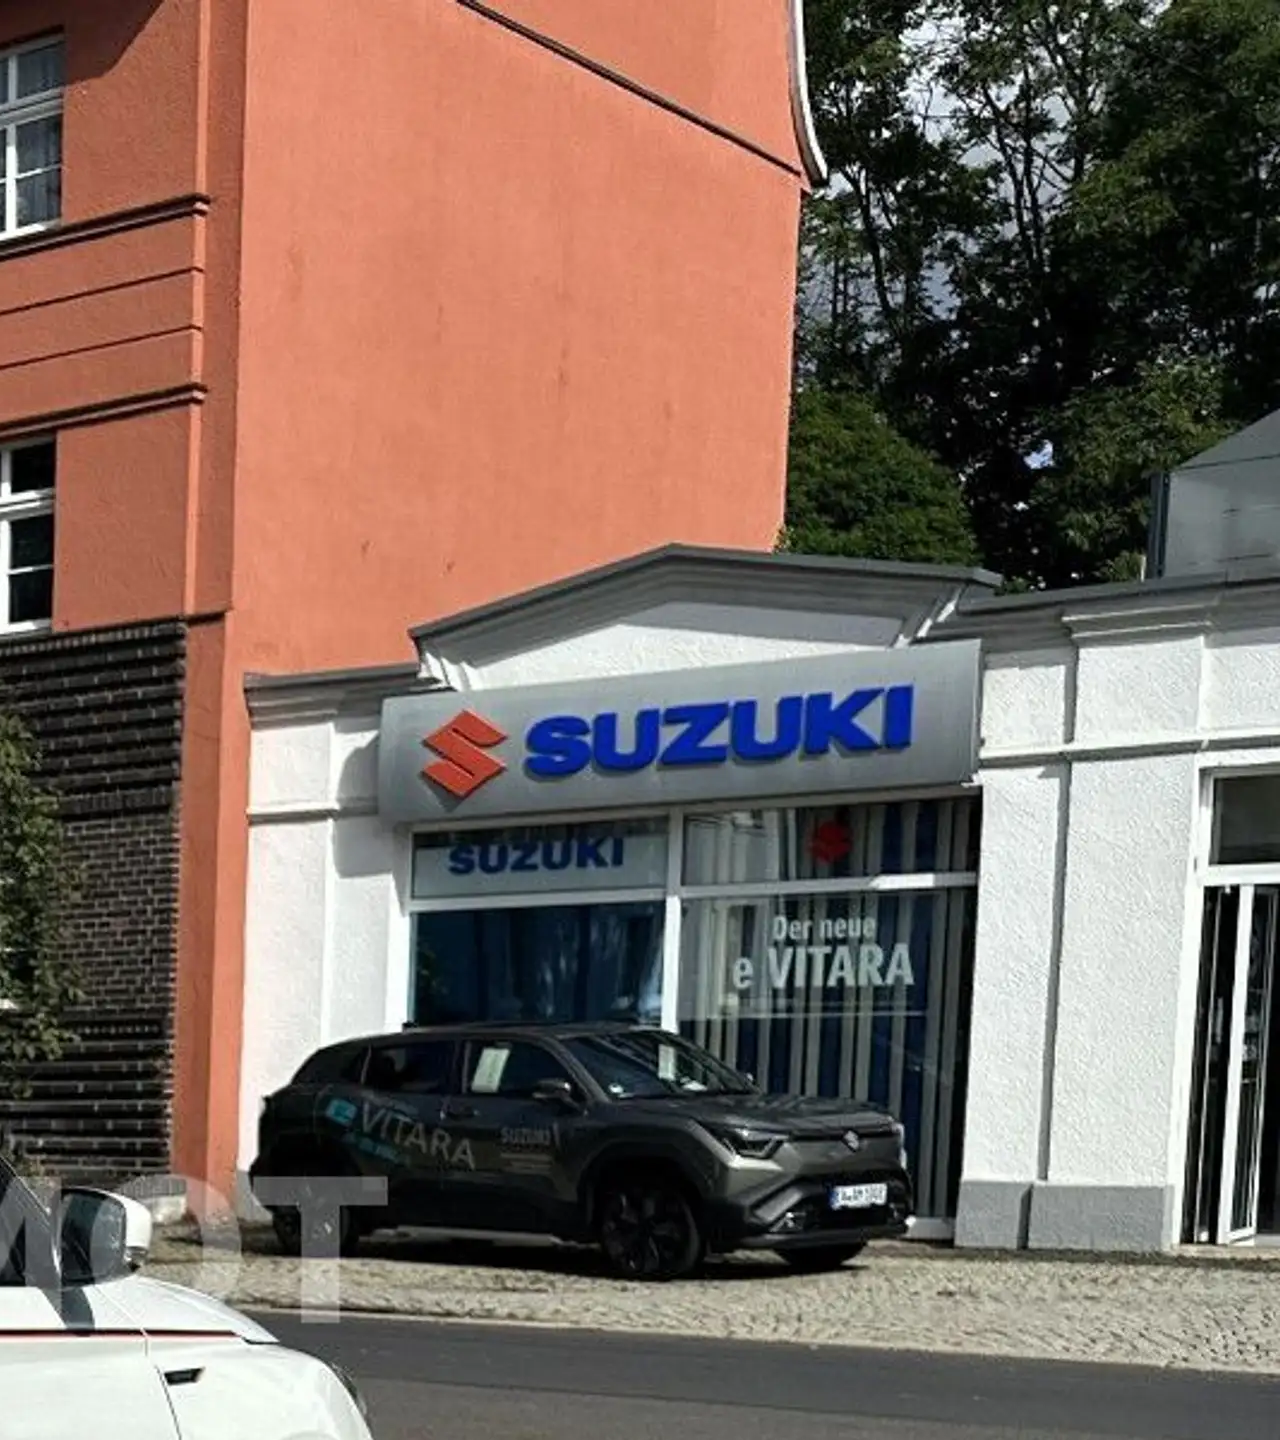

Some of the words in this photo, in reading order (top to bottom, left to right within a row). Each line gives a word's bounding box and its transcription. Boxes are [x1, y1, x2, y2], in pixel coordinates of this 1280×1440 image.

[526, 685, 914, 777] SUZUKI
[448, 836, 624, 876] SUZUKI
[772, 915, 811, 941] Der
[819, 915, 877, 939] neue
[733, 957, 755, 990] e
[768, 942, 915, 989] VITARA
[361, 1102, 476, 1171] VITARA
